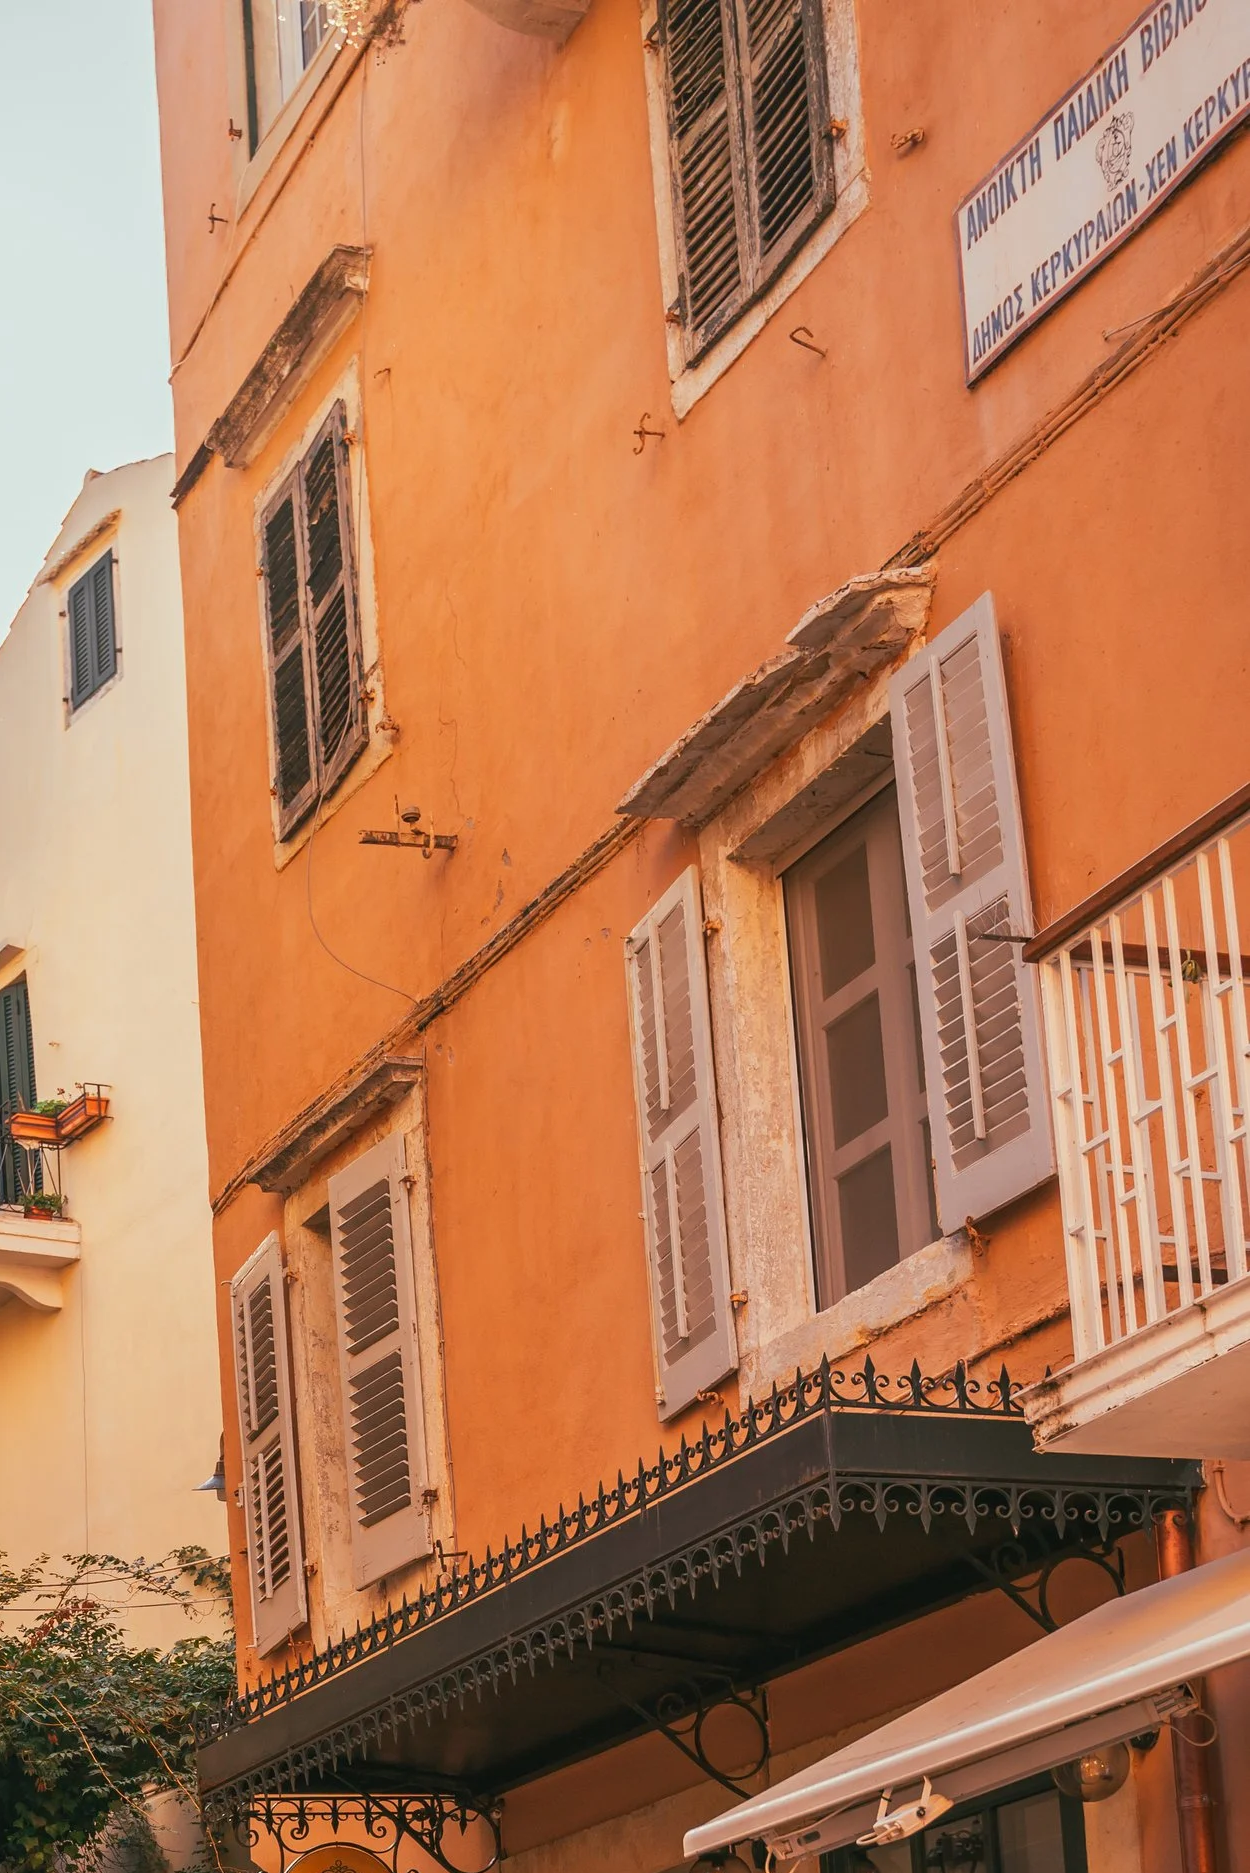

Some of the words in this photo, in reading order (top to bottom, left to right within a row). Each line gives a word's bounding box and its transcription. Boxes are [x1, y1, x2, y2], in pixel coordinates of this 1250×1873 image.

[967, 137, 1042, 251] ΑΝΟΙΚΤΗ
[1053, 48, 1129, 162] ΠΑΙΔΙΚΗ
[1139, 0, 1208, 73] ΒΙΒΛΙ
[972, 284, 1025, 365] ΔΗΜΟΣ
